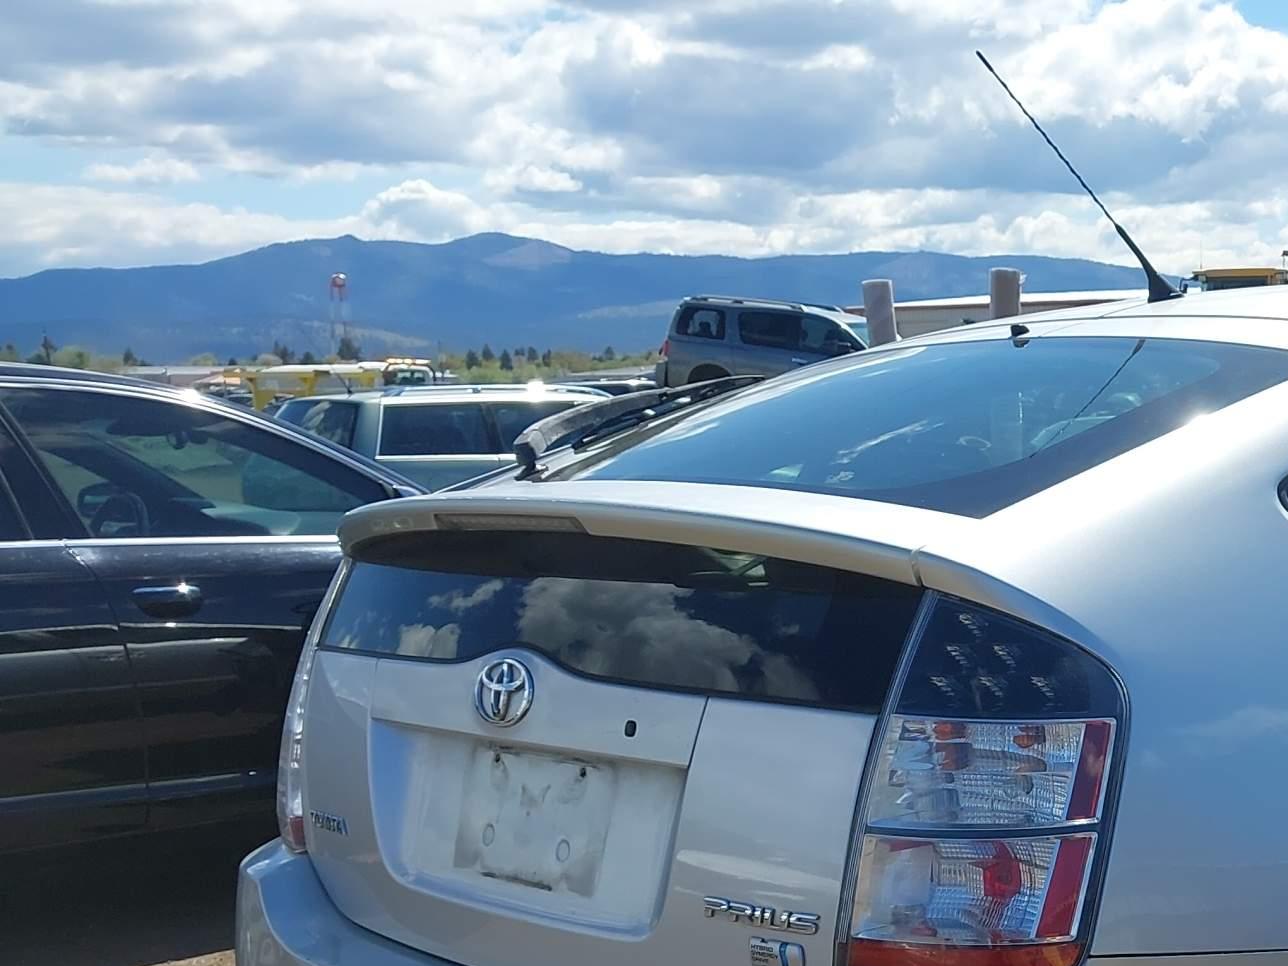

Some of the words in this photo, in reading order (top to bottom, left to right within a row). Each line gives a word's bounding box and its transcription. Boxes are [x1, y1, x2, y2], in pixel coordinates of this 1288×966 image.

[310, 810, 348, 835] TOYOTA
[703, 895, 821, 936] PRIUS
[750, 944, 774, 953] HYBRID
